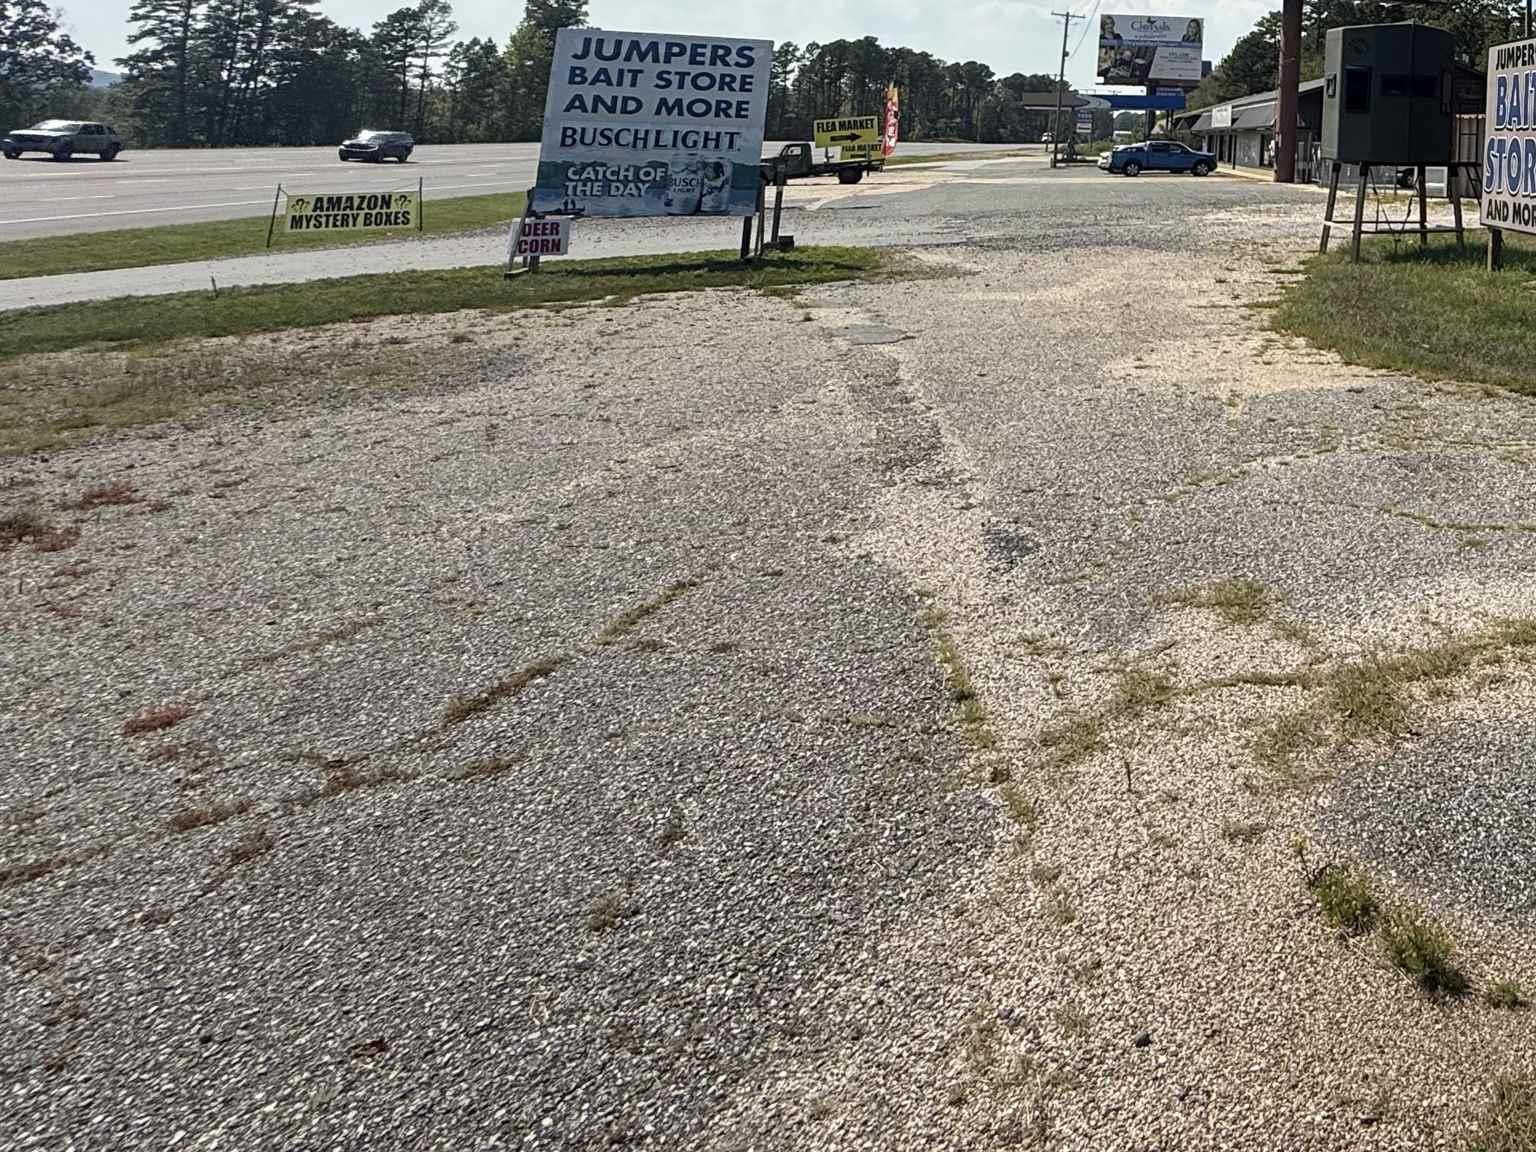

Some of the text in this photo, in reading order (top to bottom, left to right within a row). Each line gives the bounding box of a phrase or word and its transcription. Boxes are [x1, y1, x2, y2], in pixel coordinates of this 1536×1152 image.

[571, 37, 755, 68] JUMPERS
[567, 66, 754, 92] BAIT STORE
[563, 94, 750, 119] AND MORE
[816, 119, 874, 133] FLEA MARKET
[559, 126, 650, 149] BUSCH
[567, 166, 666, 181] CATCH OF
[565, 181, 650, 198] THE DAY
[312, 194, 393, 212] AMAZON
[1487, 199, 1509, 223] AND
[290, 211, 411, 230] MYSTERY BOXES
[522, 221, 561, 237] DEER
[518, 239, 561, 253] CORN
